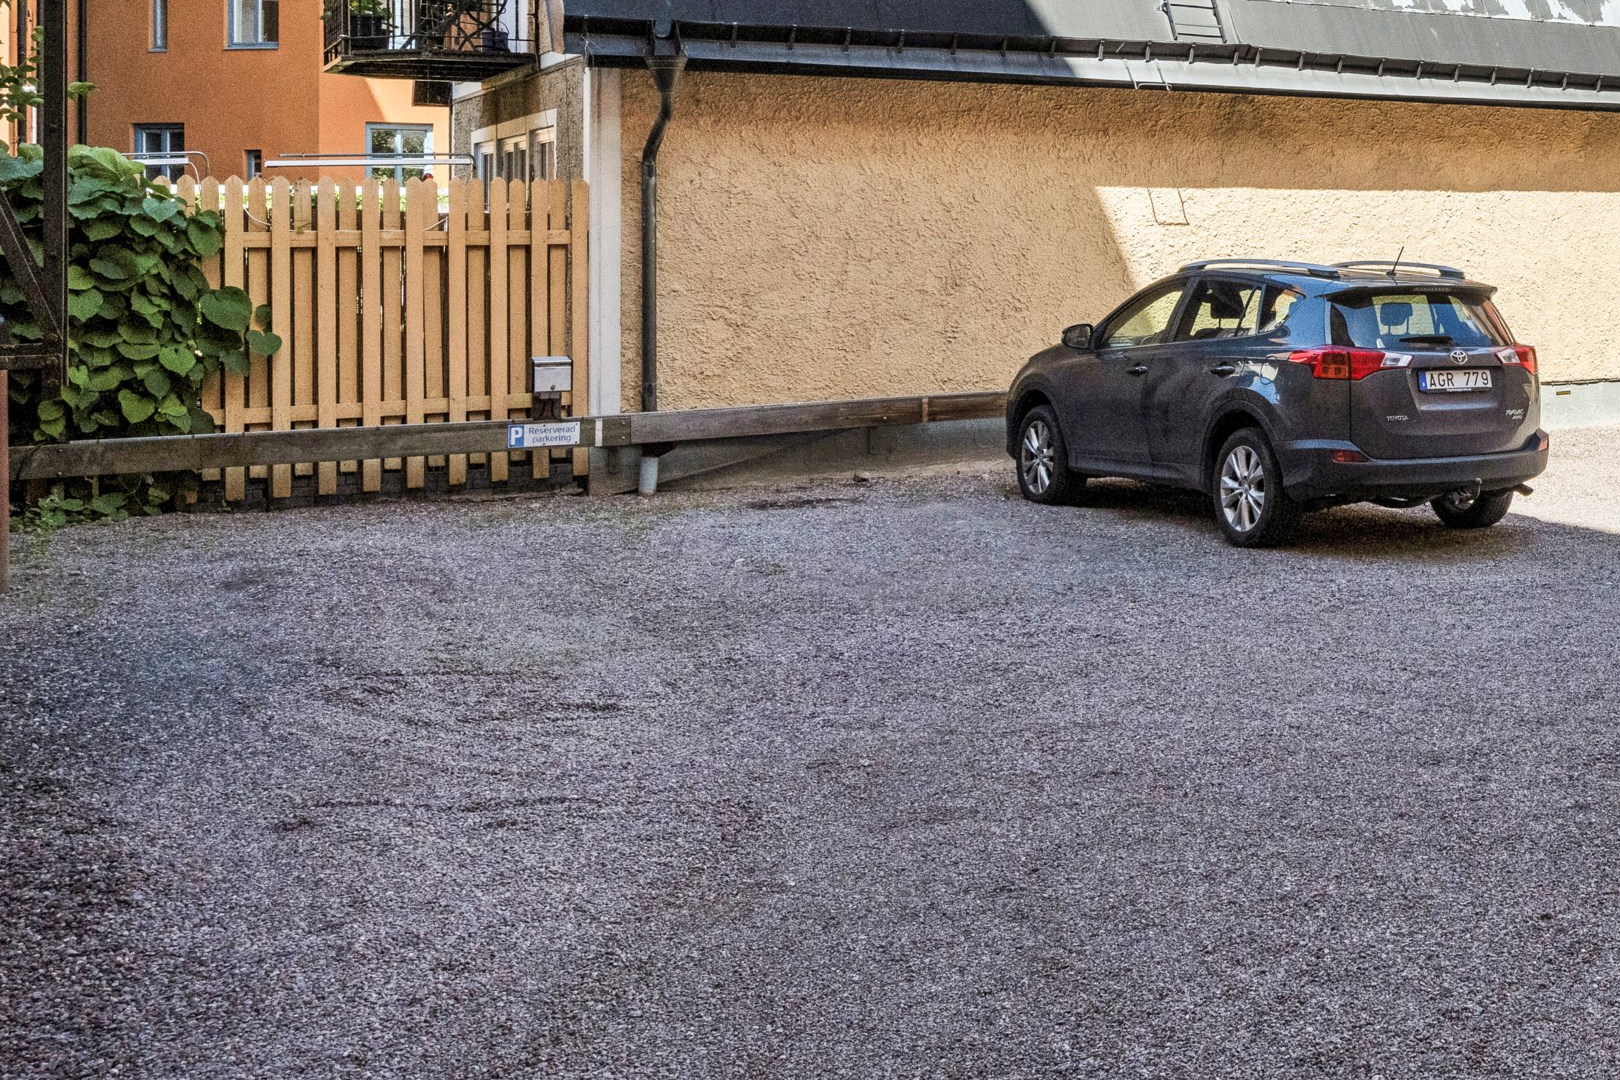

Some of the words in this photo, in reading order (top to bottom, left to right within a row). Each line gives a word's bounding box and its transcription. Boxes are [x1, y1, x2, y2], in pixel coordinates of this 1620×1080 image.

[1429, 372, 1455, 387] AGR
[1463, 371, 1489, 386] 779
[510, 427, 523, 445] P
[528, 426, 576, 434] Reserverad
[532, 434, 572, 444] parkering
